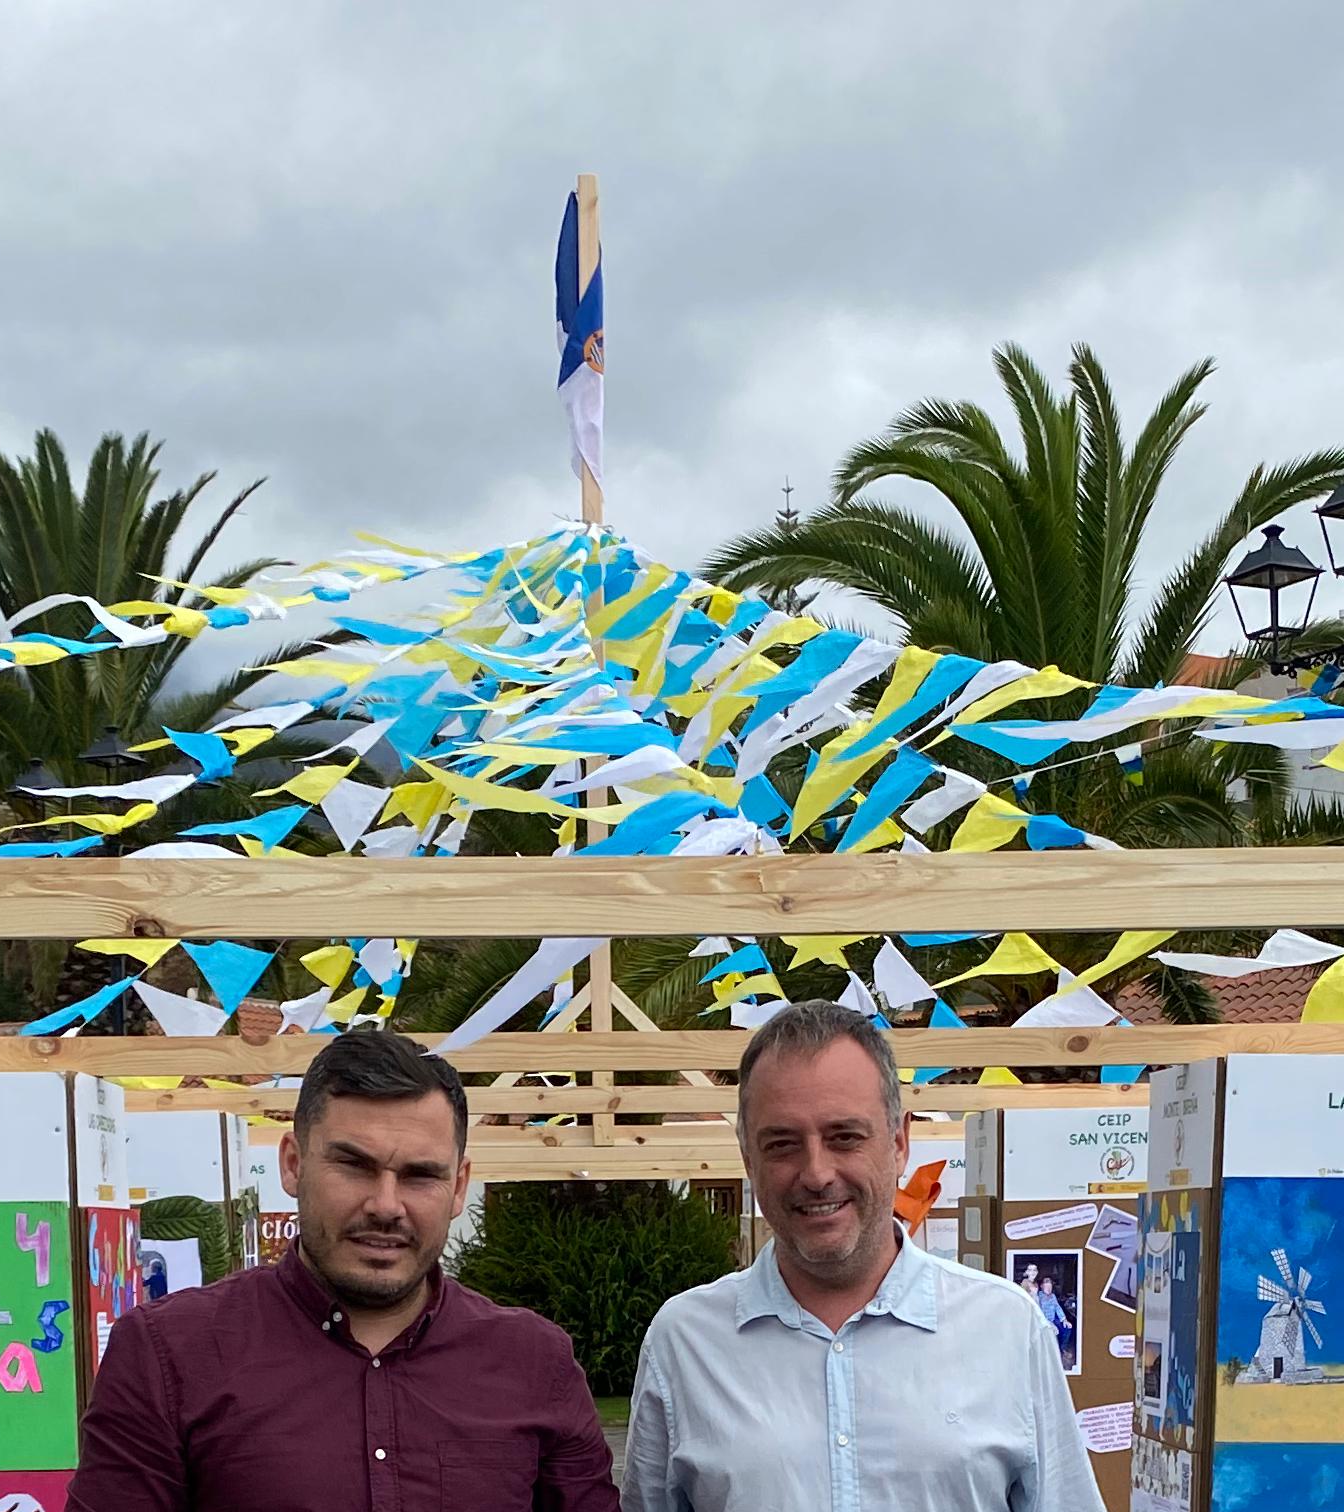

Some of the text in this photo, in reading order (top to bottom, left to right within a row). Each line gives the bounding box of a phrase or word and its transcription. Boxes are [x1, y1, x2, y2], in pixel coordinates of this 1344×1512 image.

[1098, 1114, 1131, 1126] CEIP
[1069, 1132, 1148, 1145] SAN VICEN
